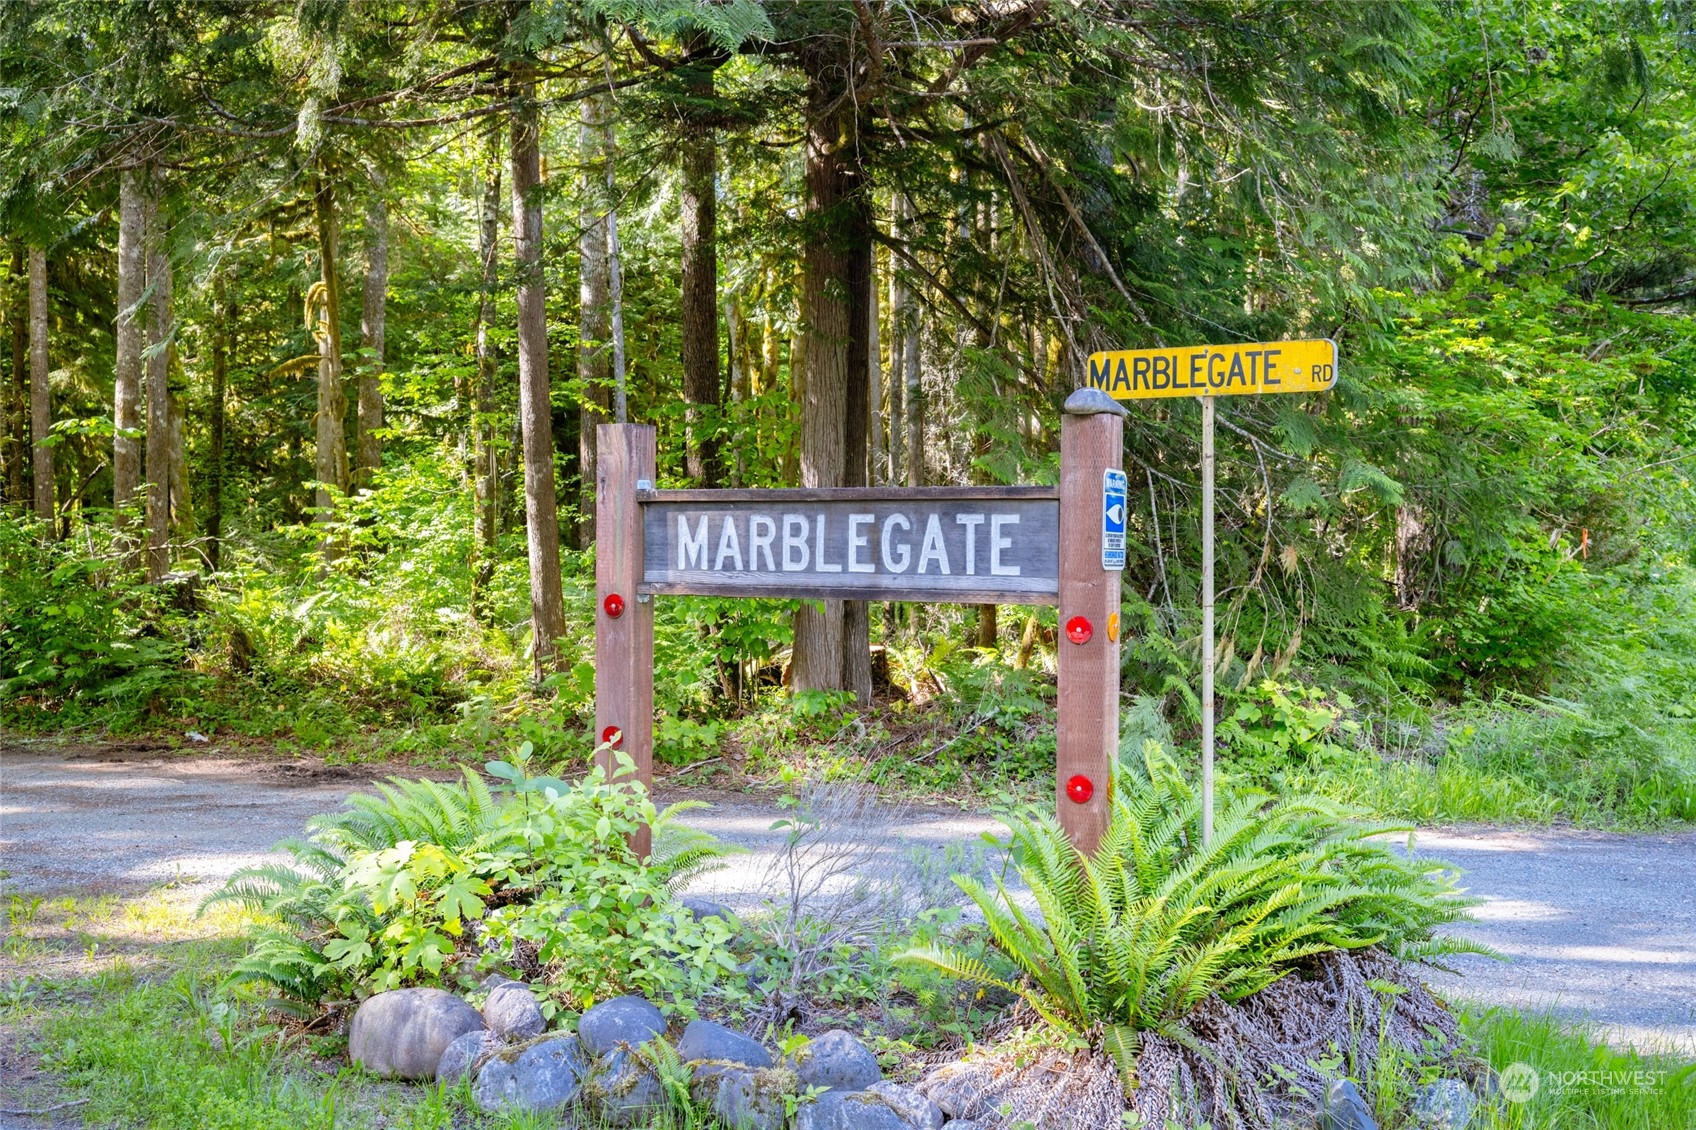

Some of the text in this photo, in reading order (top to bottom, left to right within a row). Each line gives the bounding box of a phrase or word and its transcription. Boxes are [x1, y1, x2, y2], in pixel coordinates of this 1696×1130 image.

[1090, 350, 1333, 391] MARBLEGATE RD
[677, 513, 1021, 576] MARBLEGATE
